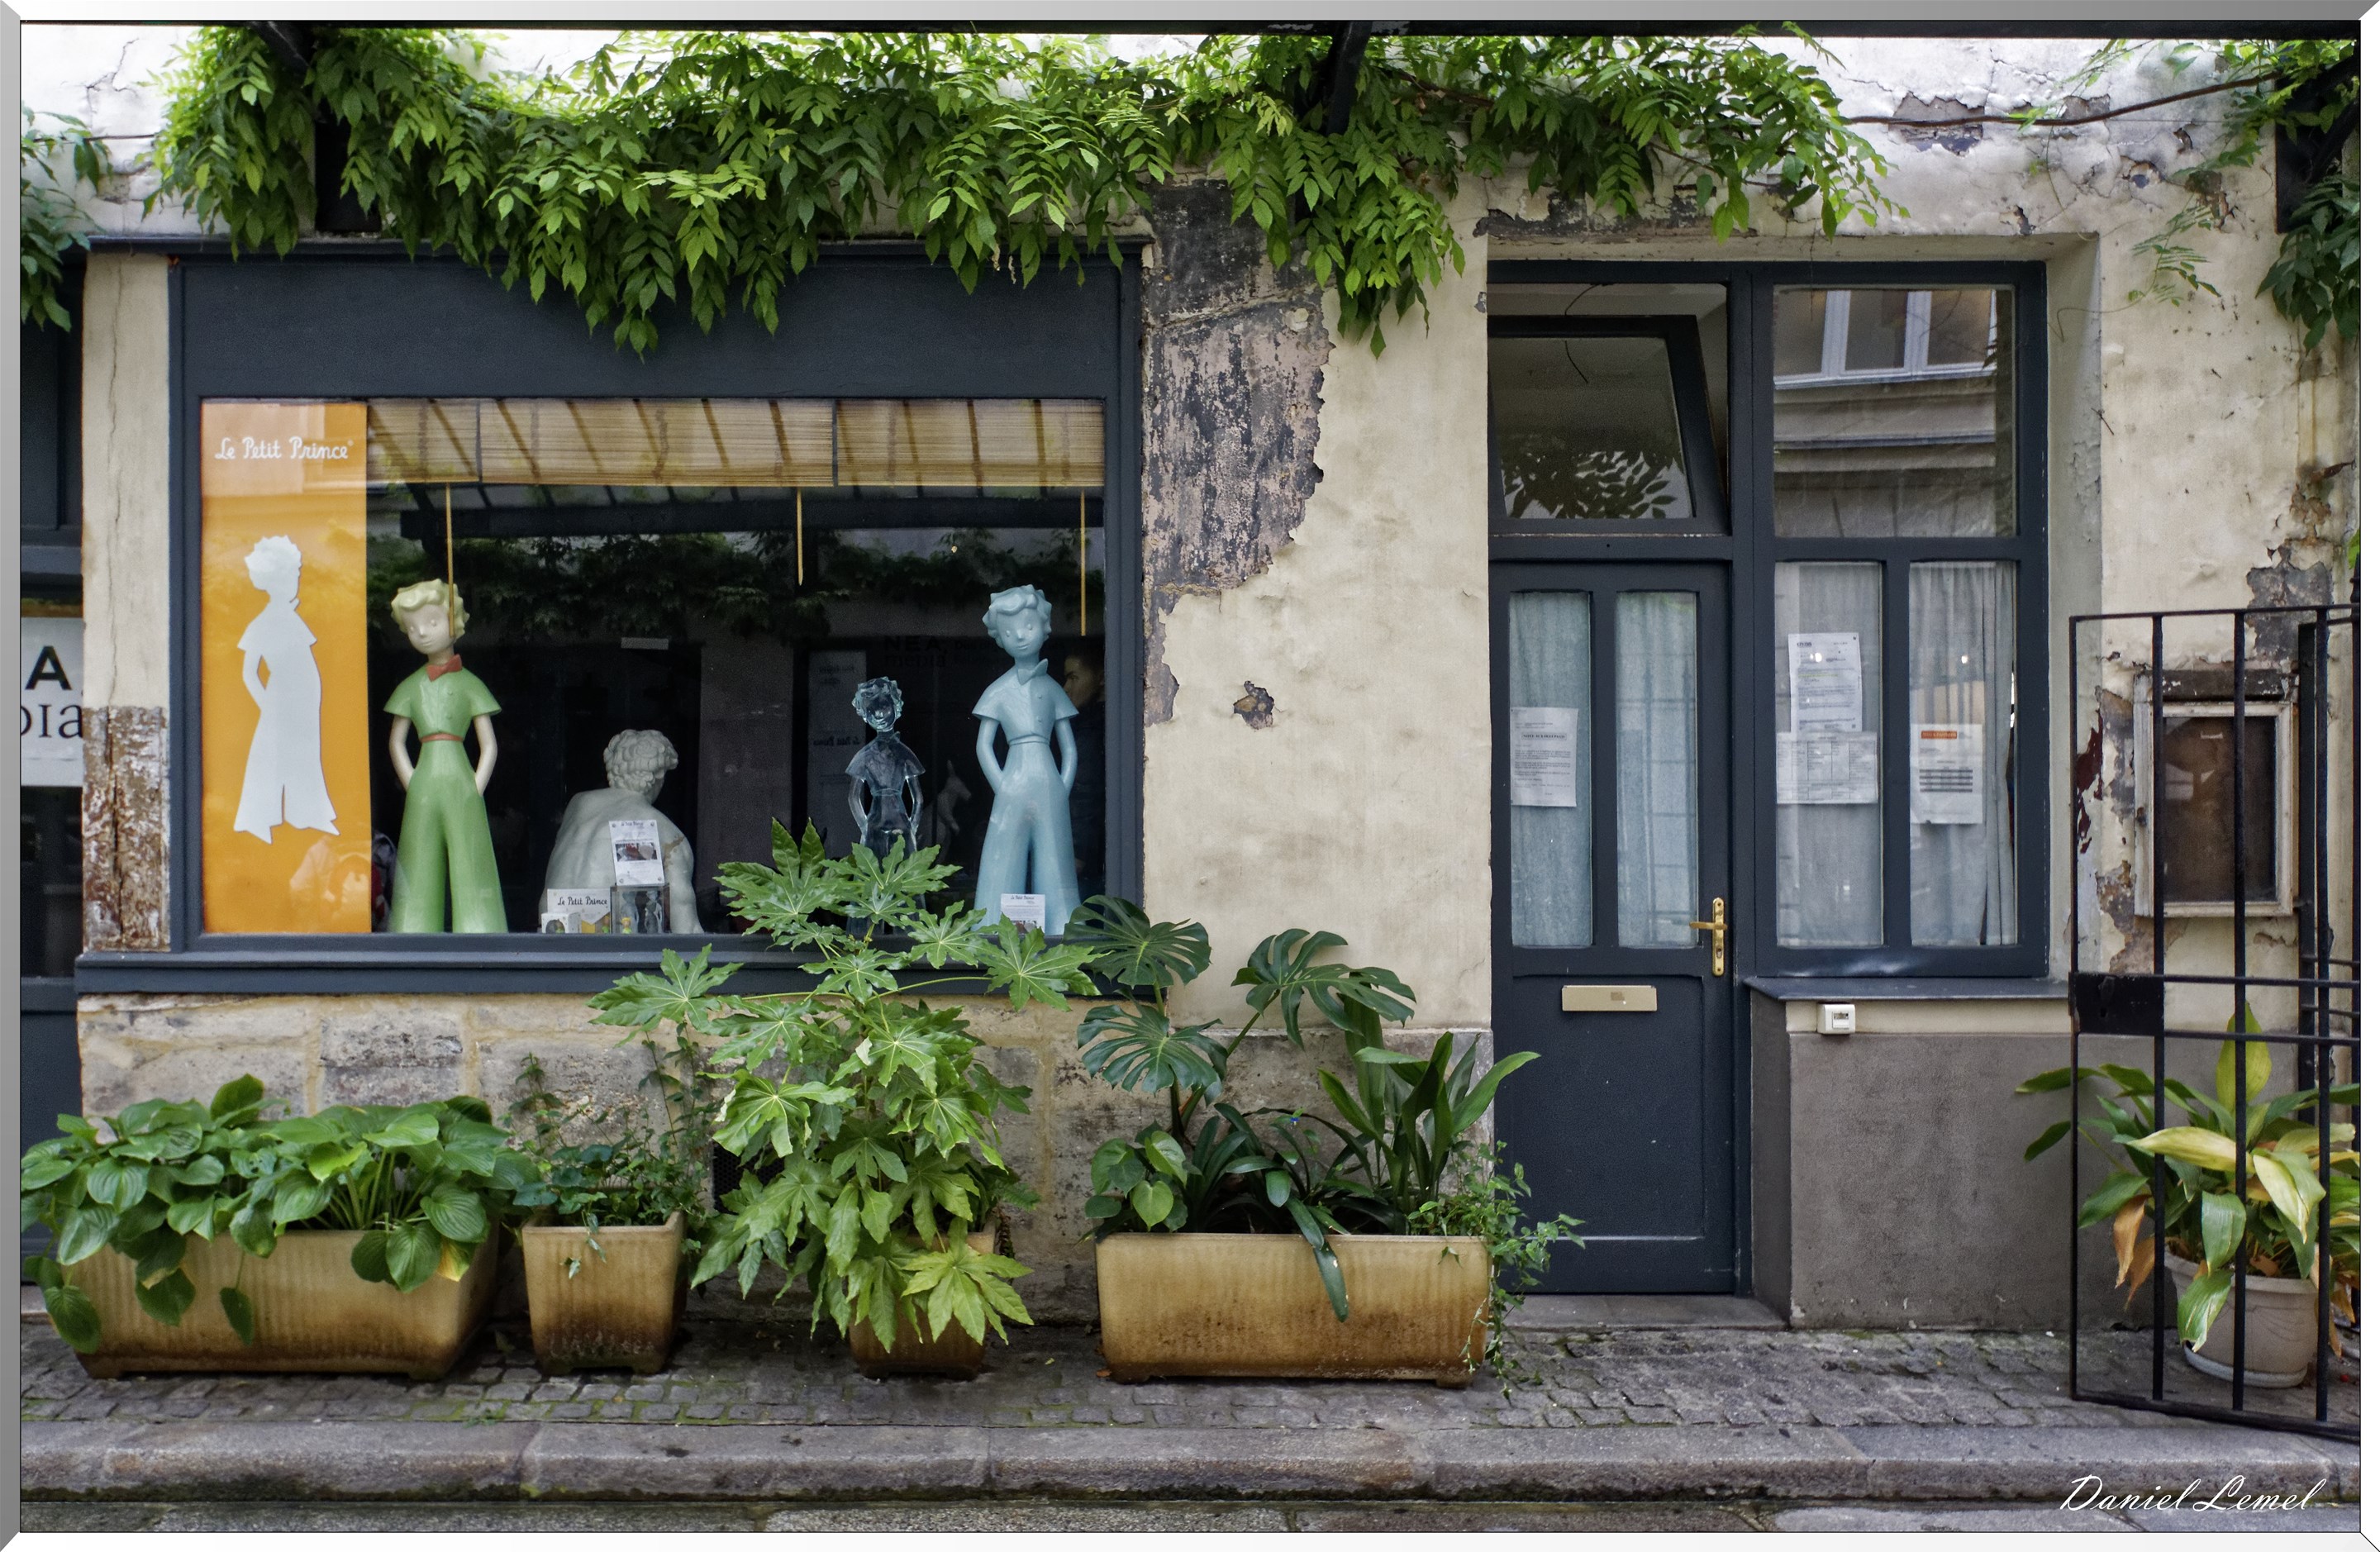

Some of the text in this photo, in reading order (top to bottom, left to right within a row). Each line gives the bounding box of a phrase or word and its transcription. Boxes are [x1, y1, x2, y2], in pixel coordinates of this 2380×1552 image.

[214, 436, 348, 459] Le Petit Prince
[557, 896, 607, 906] Le Petit Prince
